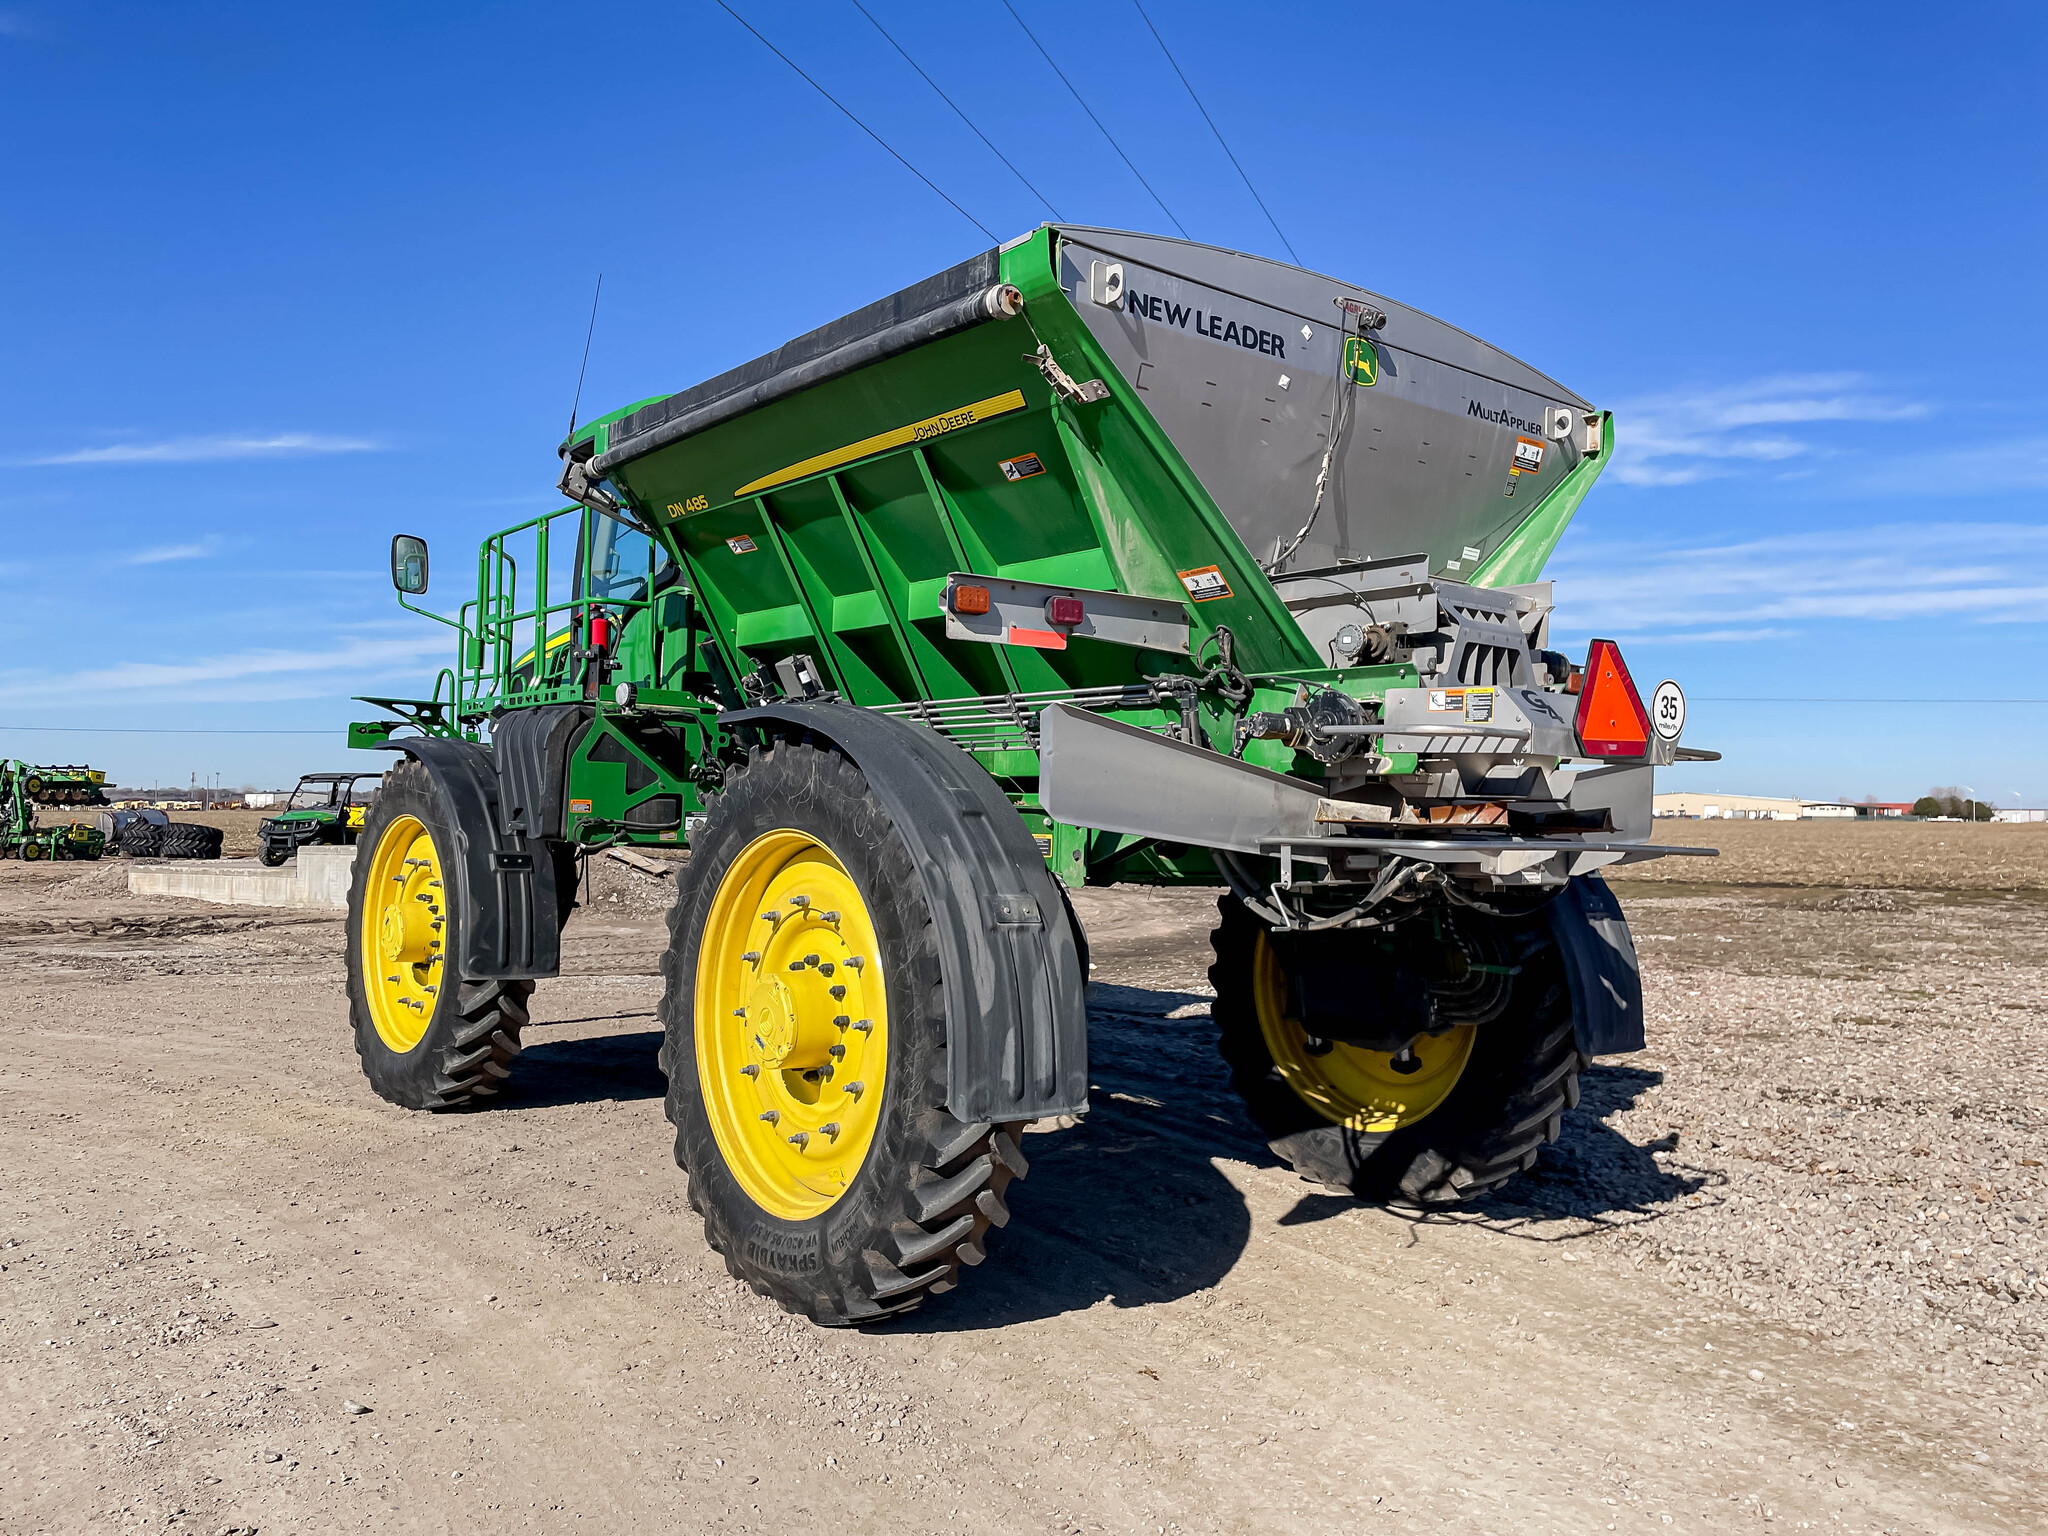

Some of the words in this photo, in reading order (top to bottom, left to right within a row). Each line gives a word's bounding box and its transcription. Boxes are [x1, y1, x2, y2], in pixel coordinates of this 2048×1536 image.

[1129, 290, 1192, 329] NEW
[1196, 310, 1286, 360] LEADER
[913, 422, 940, 440] JOHN
[938, 411, 976, 430] DEERE
[667, 502, 686, 518] DN
[686, 495, 709, 512] 485
[1660, 695, 1678, 720] 35
